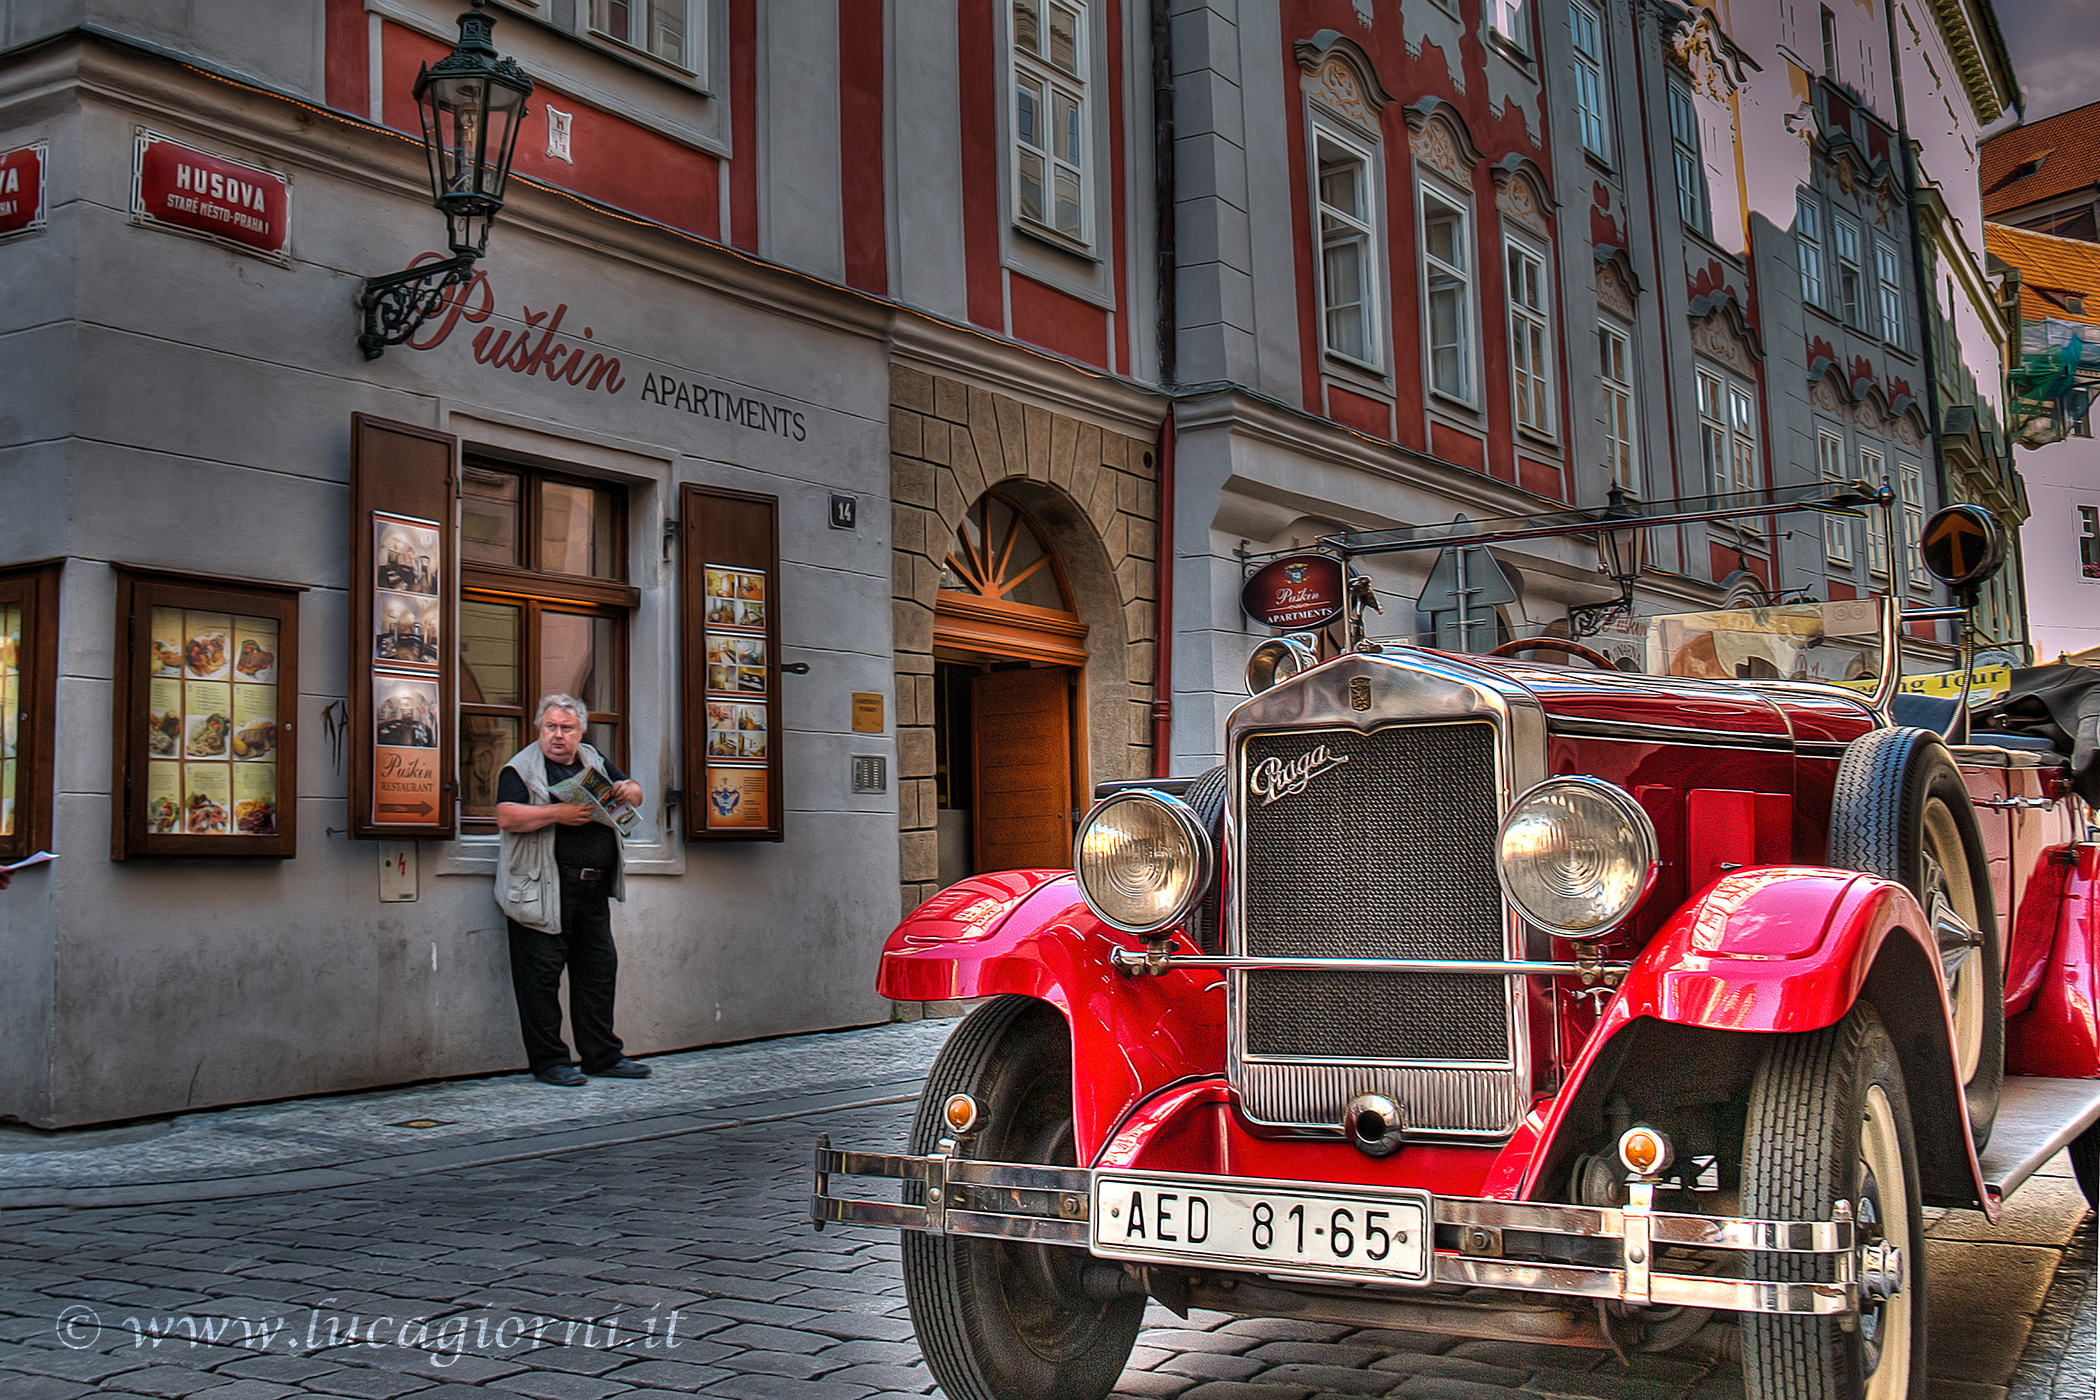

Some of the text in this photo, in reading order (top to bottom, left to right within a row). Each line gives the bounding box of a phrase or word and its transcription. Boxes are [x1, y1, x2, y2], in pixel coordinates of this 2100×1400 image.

[176, 163, 265, 213] HUSOVA
[167, 193, 269, 235] STARÉ MĚSTO-PRAHA 1
[641, 371, 806, 442] APARTMENTS
[838, 502, 852, 522] 14
[1275, 587, 1320, 605] Puškin
[1267, 607, 1333, 624] APARTMENTS
[1935, 671, 2003, 689] Tour
[381, 752, 433, 779] Puškin
[1250, 744, 1350, 807] Praga
[381, 781, 434, 793] RESTAURANT
[1126, 1190, 1390, 1261] AED 81-65
